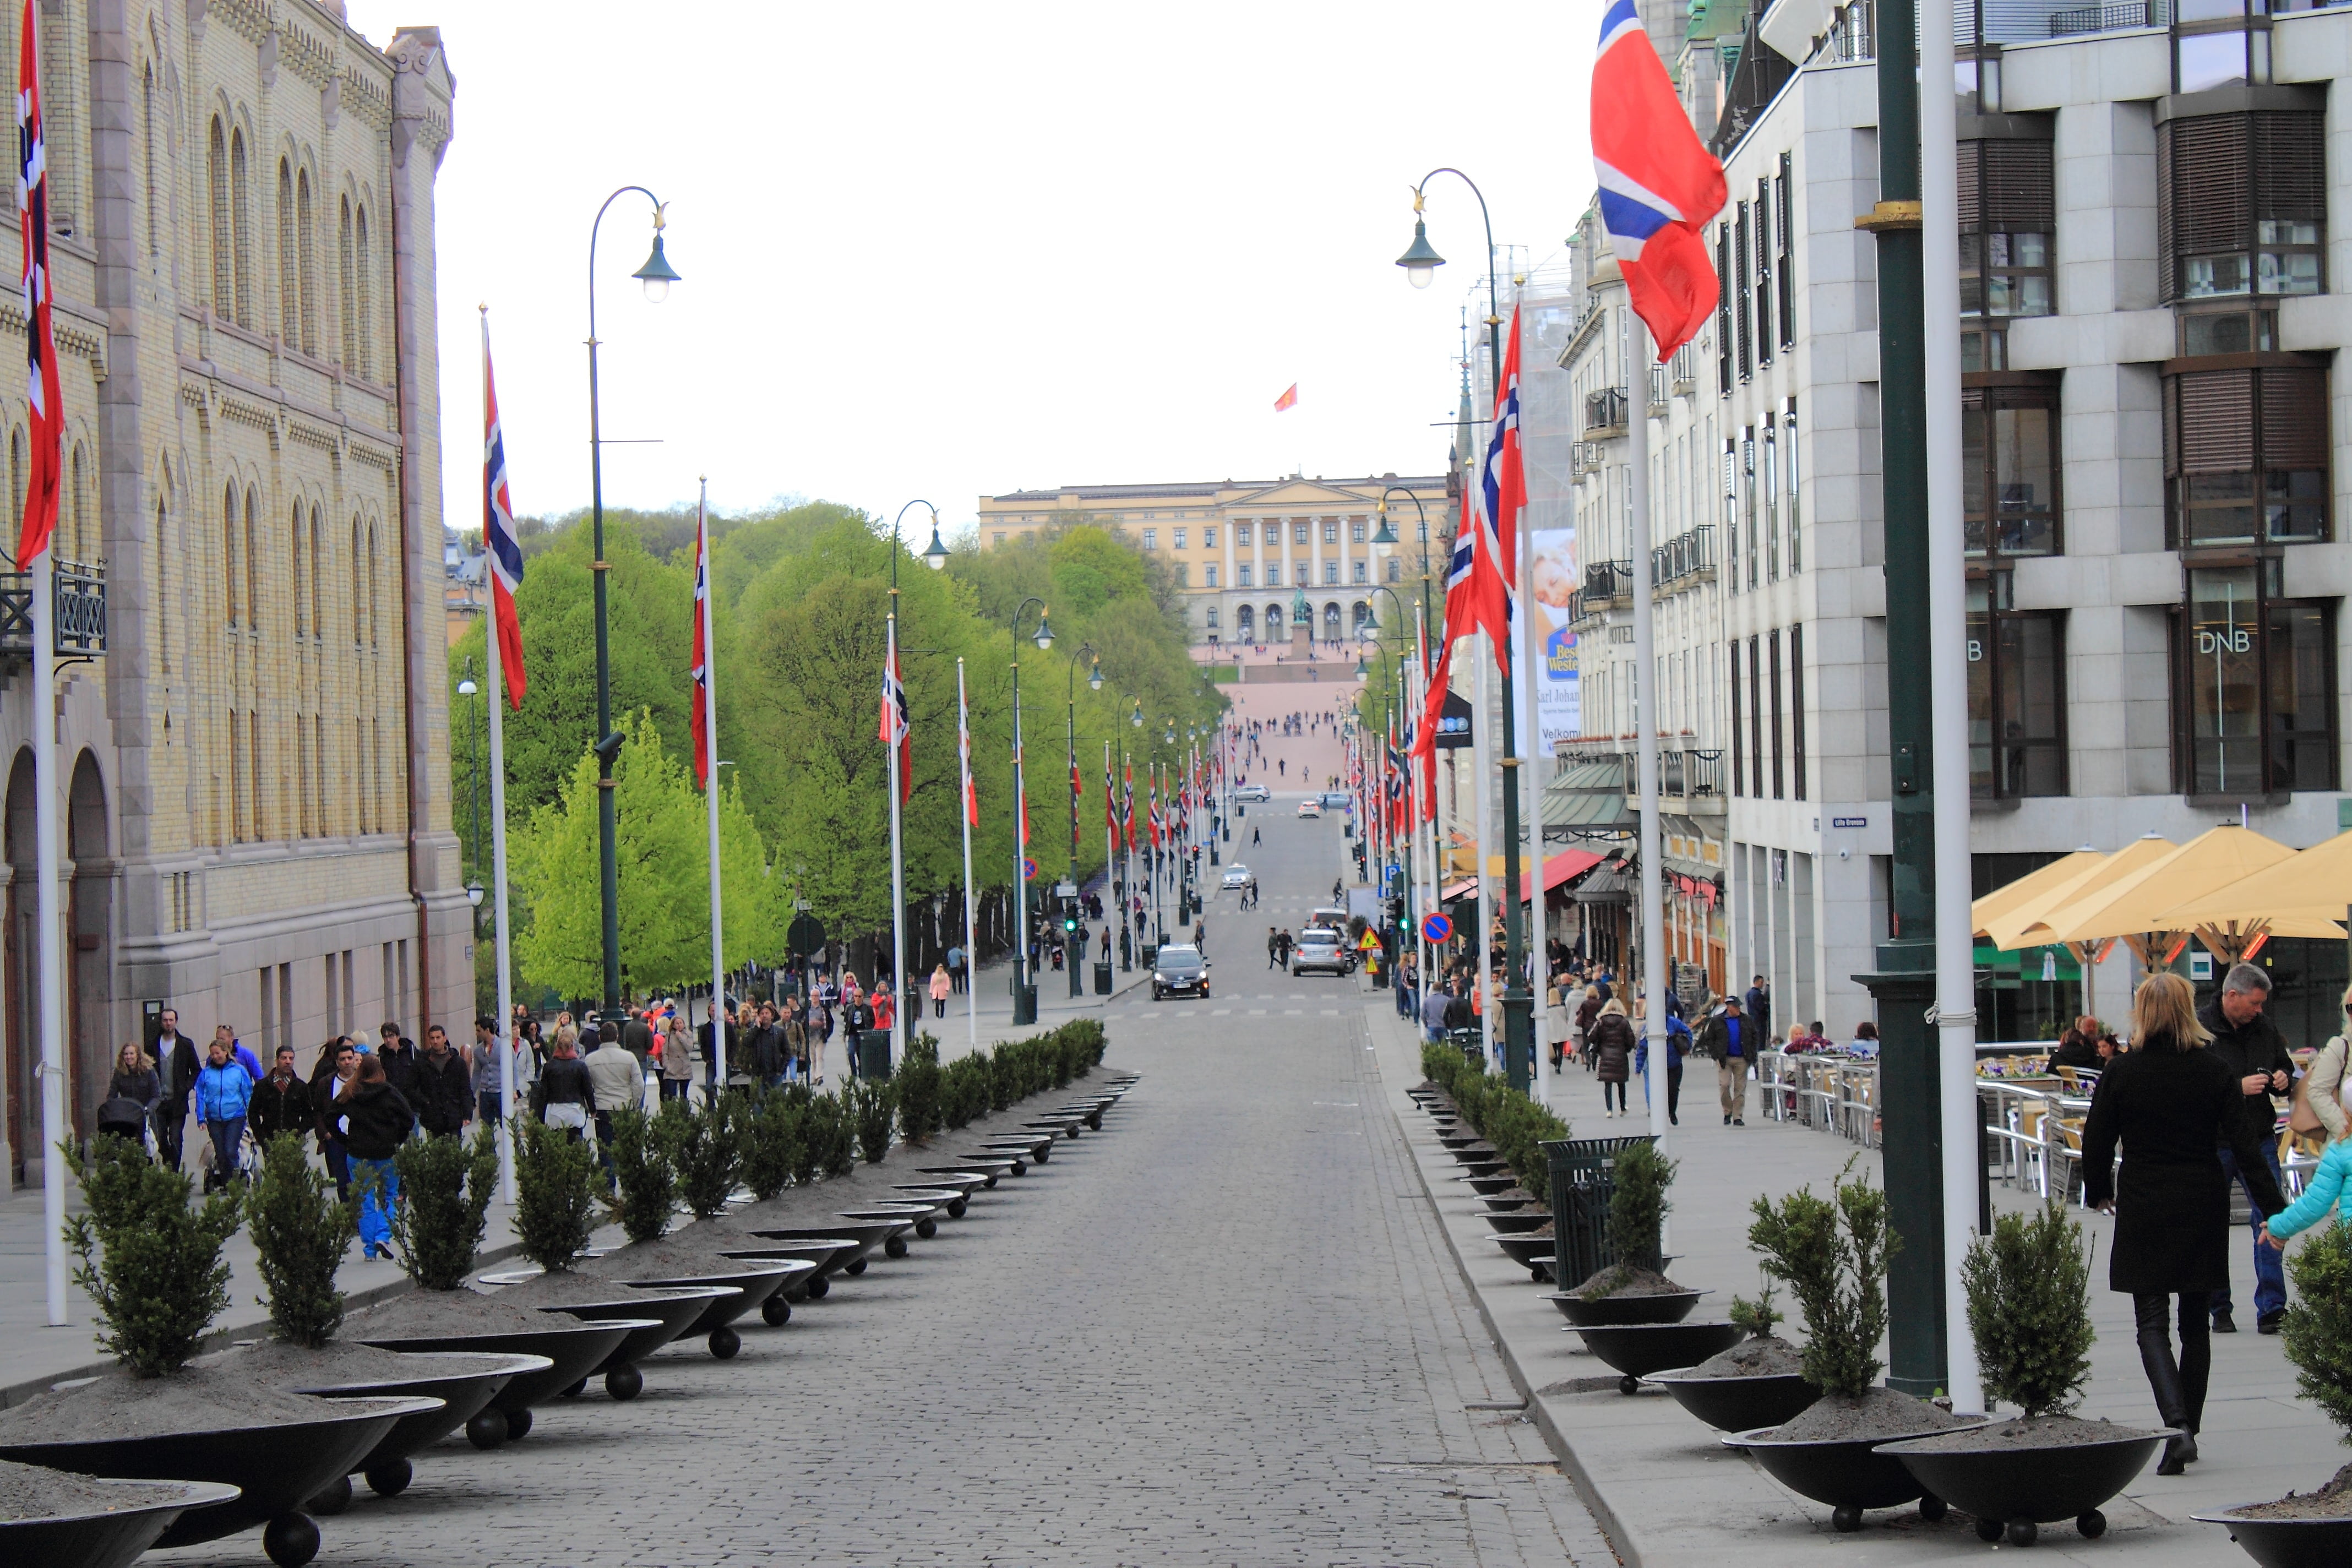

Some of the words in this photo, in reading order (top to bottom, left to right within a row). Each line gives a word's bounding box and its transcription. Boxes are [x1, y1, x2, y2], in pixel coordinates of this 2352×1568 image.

[1609, 625, 1636, 644] HOTEL
[2199, 630, 2250, 654] DNB
[1555, 689, 1580, 703] Johan
[1542, 728, 1581, 739] Velkom
[1389, 867, 1397, 880] P
